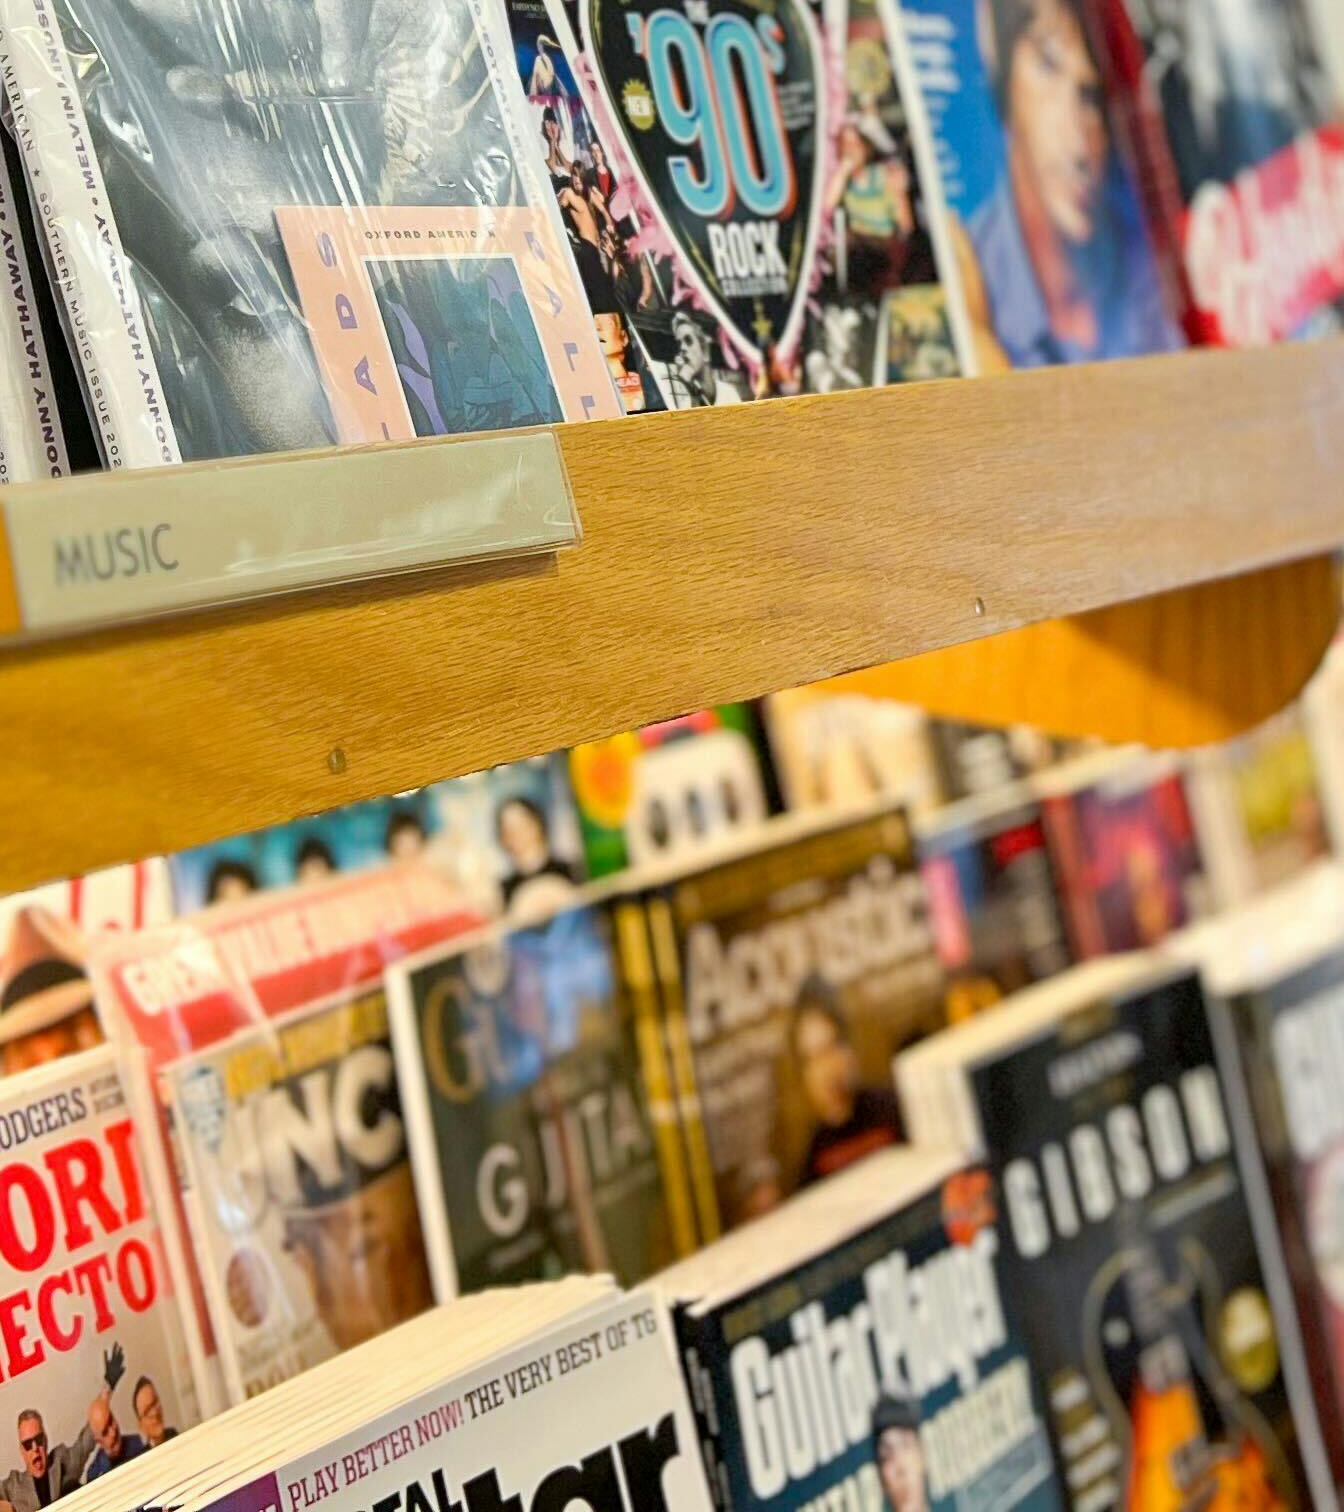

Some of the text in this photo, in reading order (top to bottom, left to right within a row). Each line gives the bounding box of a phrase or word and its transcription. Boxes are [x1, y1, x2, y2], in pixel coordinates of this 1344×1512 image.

[60, 94, 96, 190] MELVIN
[0, 228, 42, 379] HATHAWAY
[38, 192, 74, 294] SOUTHERN
[70, 299, 93, 362] MUSIC
[89, 367, 111, 426] ISSUE
[427, 229, 497, 240] AMERICN
[707, 221, 788, 278] ROCK
[52, 521, 180, 589] MUSIC
[1003, 1063, 1231, 1260] GIBSON
[286, 1461, 340, 1512] PLAY
[342, 1429, 416, 1487] BETTER
[415, 1399, 466, 1448] NOW!
[464, 1380, 506, 1422] THE
[506, 1352, 555, 1400] VERY
[556, 1333, 604, 1377] BEST
[605, 1320, 633, 1353] OF
[730, 1300, 884, 1501] Guitar
